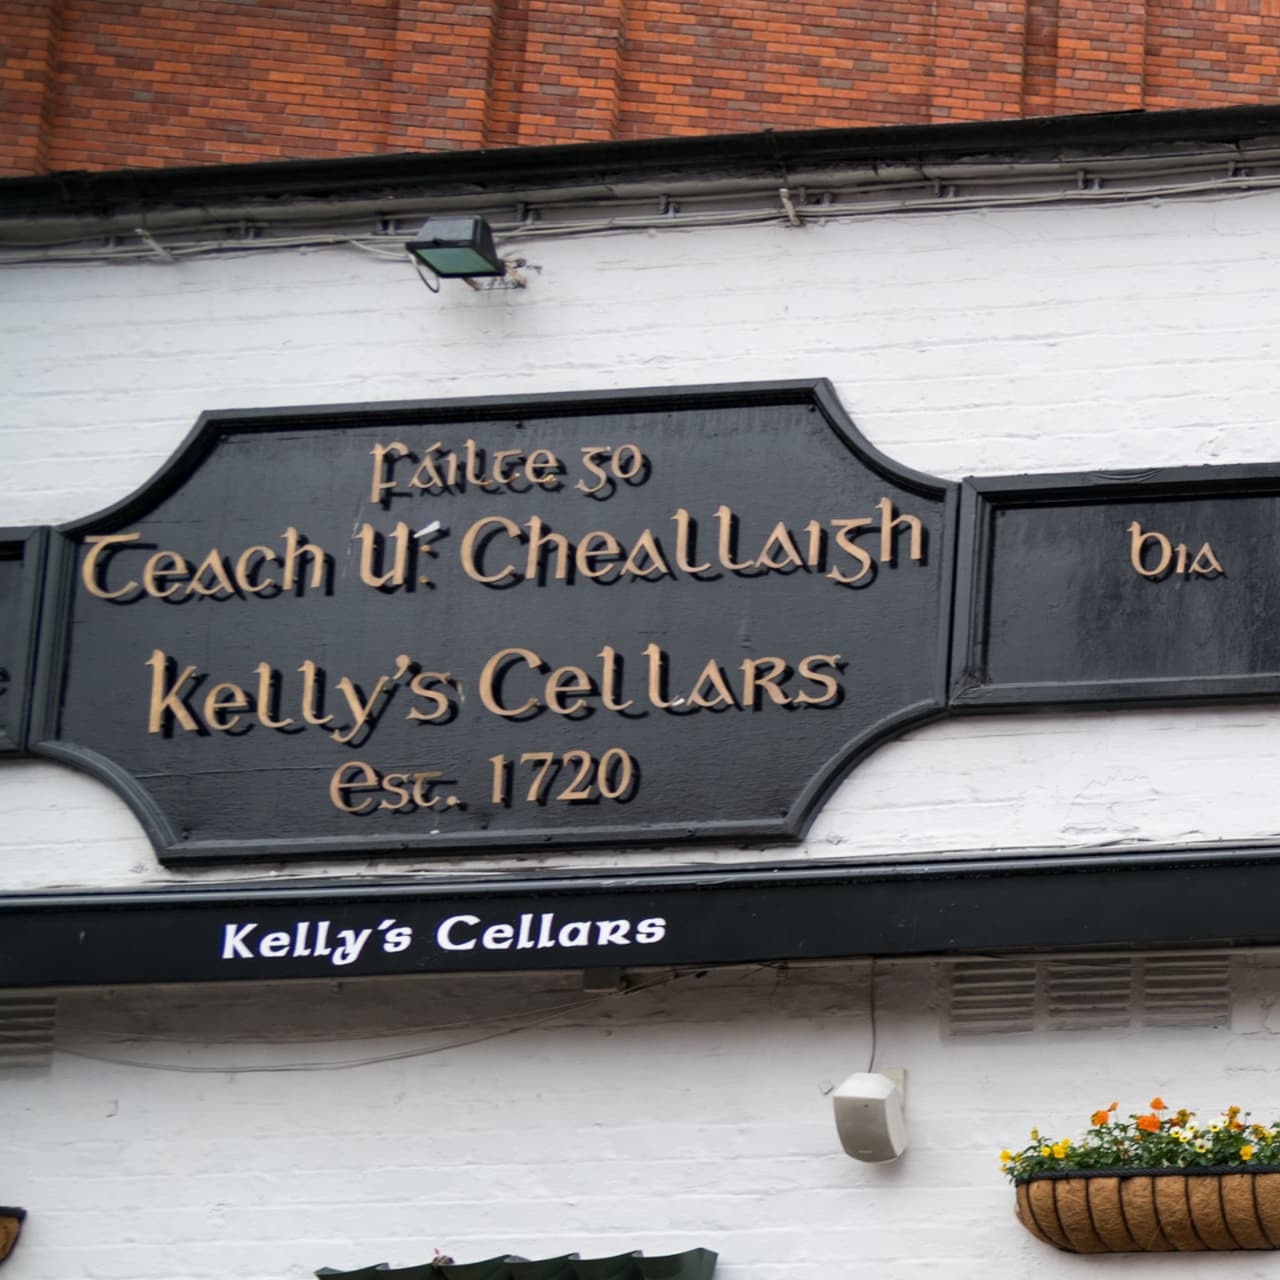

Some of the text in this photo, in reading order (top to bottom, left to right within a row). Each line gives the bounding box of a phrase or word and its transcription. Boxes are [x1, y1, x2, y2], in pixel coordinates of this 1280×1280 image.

[370, 438, 558, 503] Fáilte
[82, 528, 325, 600] Teach
[461, 497, 926, 587] Cheallaigh
[146, 641, 843, 743] Kelly's Cellars
[490, 747, 635, 804] 1720
[221, 914, 667, 966] Kelly's Cellars
